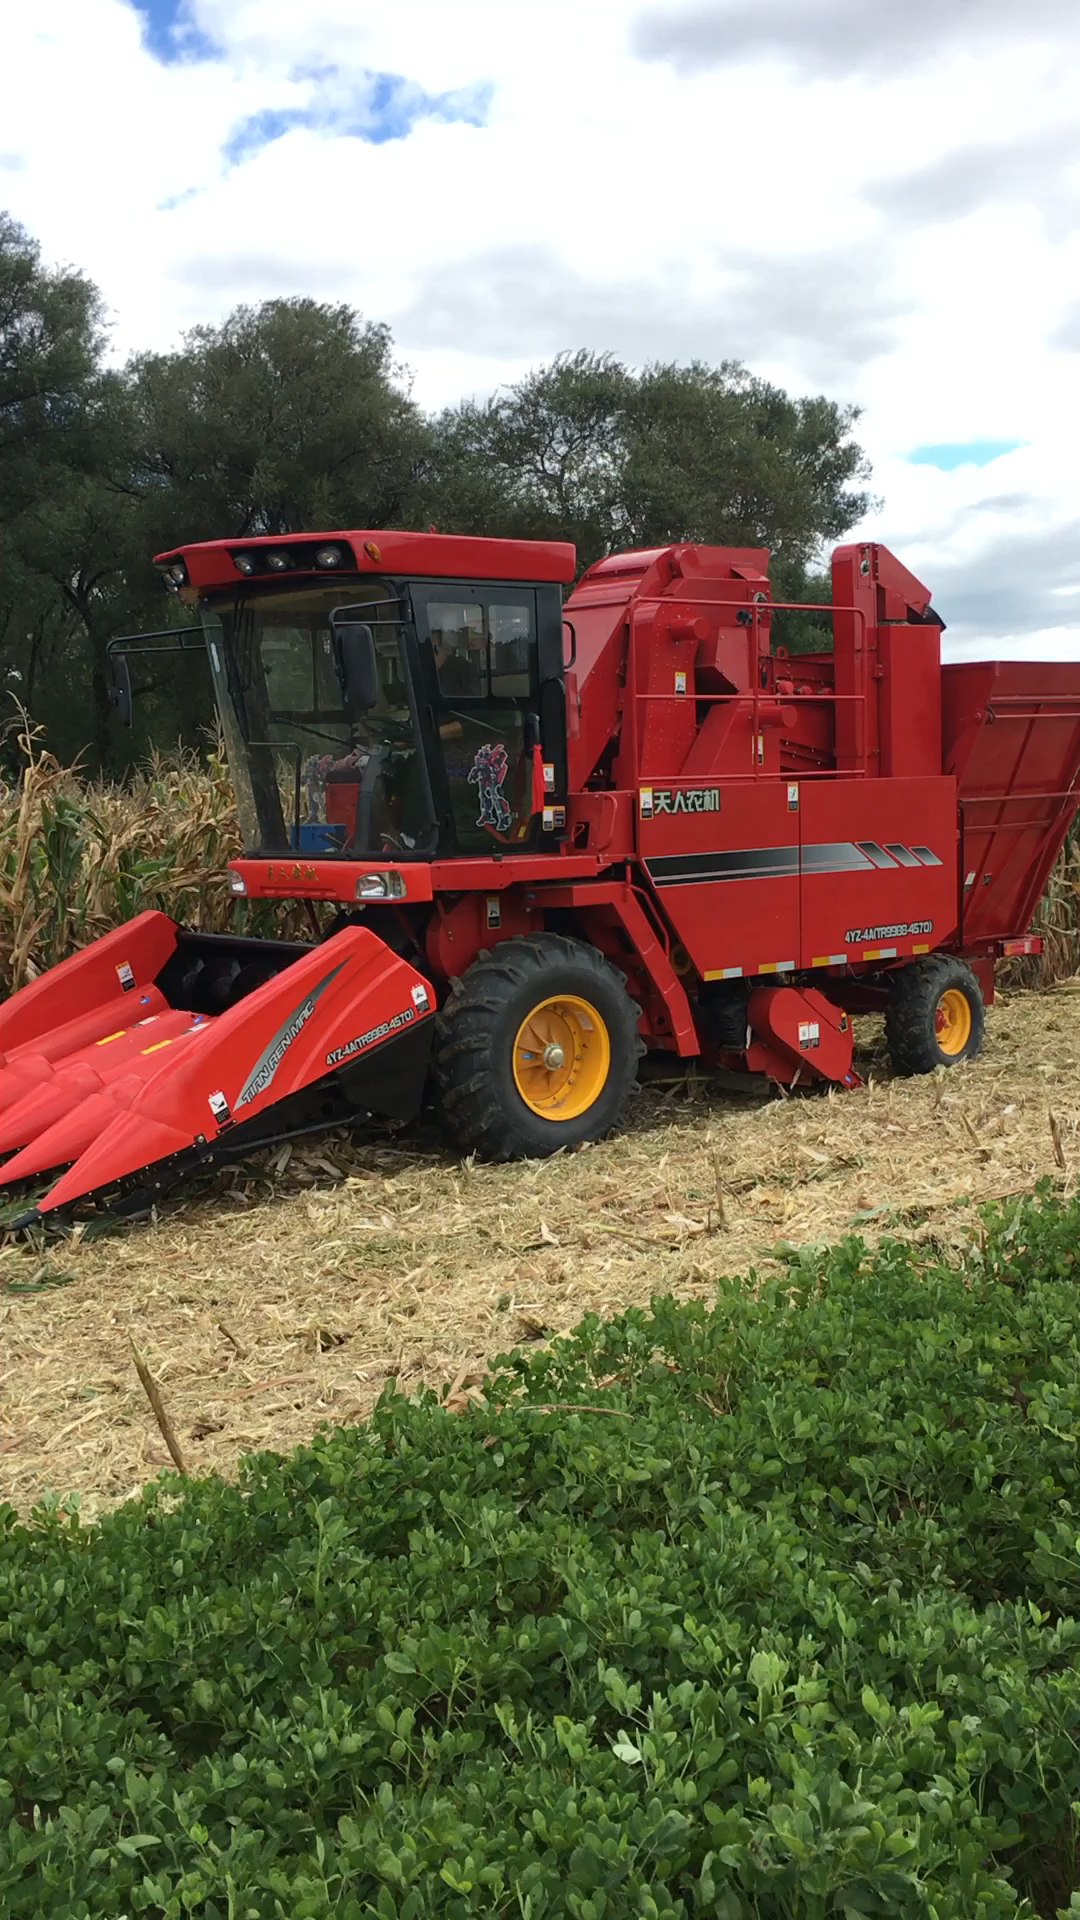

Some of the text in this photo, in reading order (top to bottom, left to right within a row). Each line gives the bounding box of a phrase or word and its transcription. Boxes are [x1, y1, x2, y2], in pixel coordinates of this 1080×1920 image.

[653, 788, 720, 815] 天人农机
[241, 1000, 315, 1104] TIAN REN MAC
